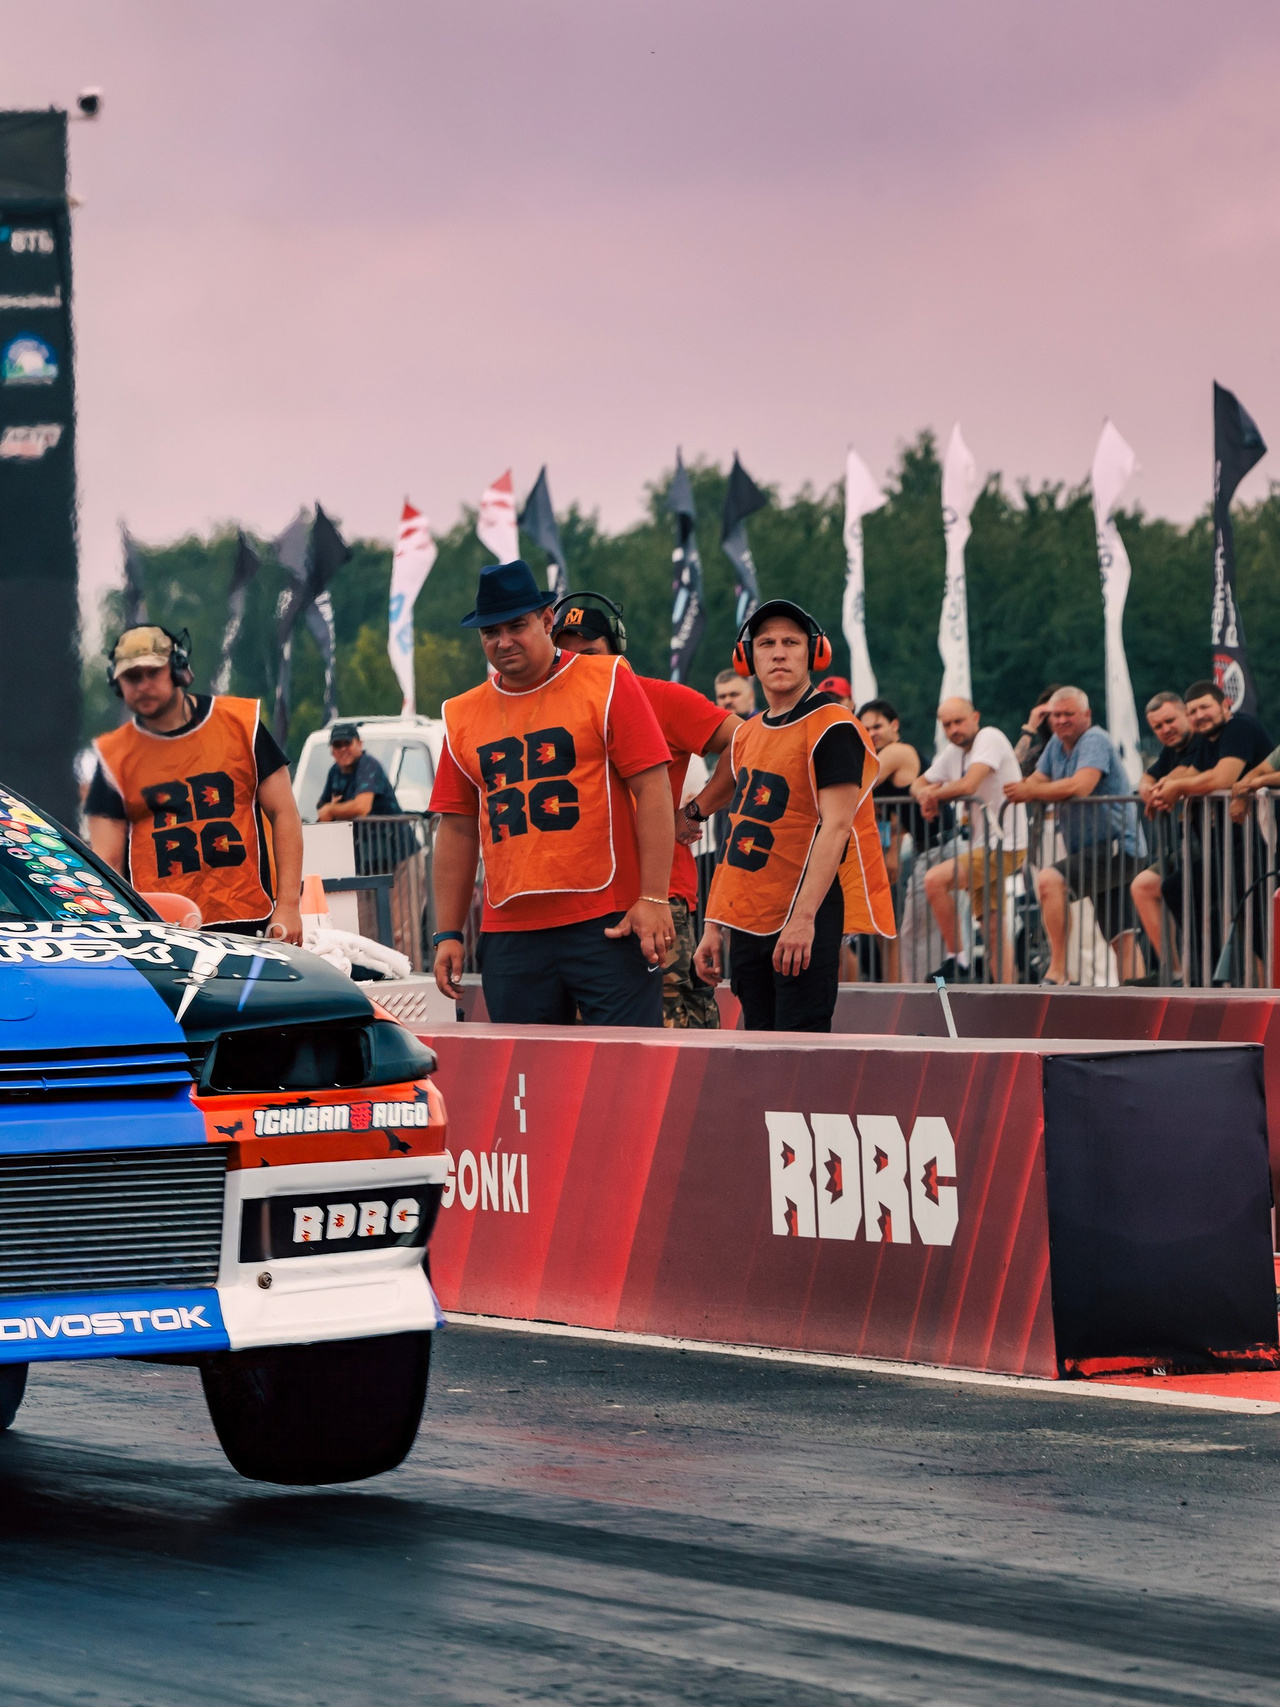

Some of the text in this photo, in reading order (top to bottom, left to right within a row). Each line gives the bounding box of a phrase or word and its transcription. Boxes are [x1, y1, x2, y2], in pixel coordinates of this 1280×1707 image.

[254, 1105, 351, 1136] ICHIBAN
[372, 1102, 429, 1127] AUTO
[765, 1111, 959, 1247] RDRC
[292, 1198, 420, 1243] RDRC
